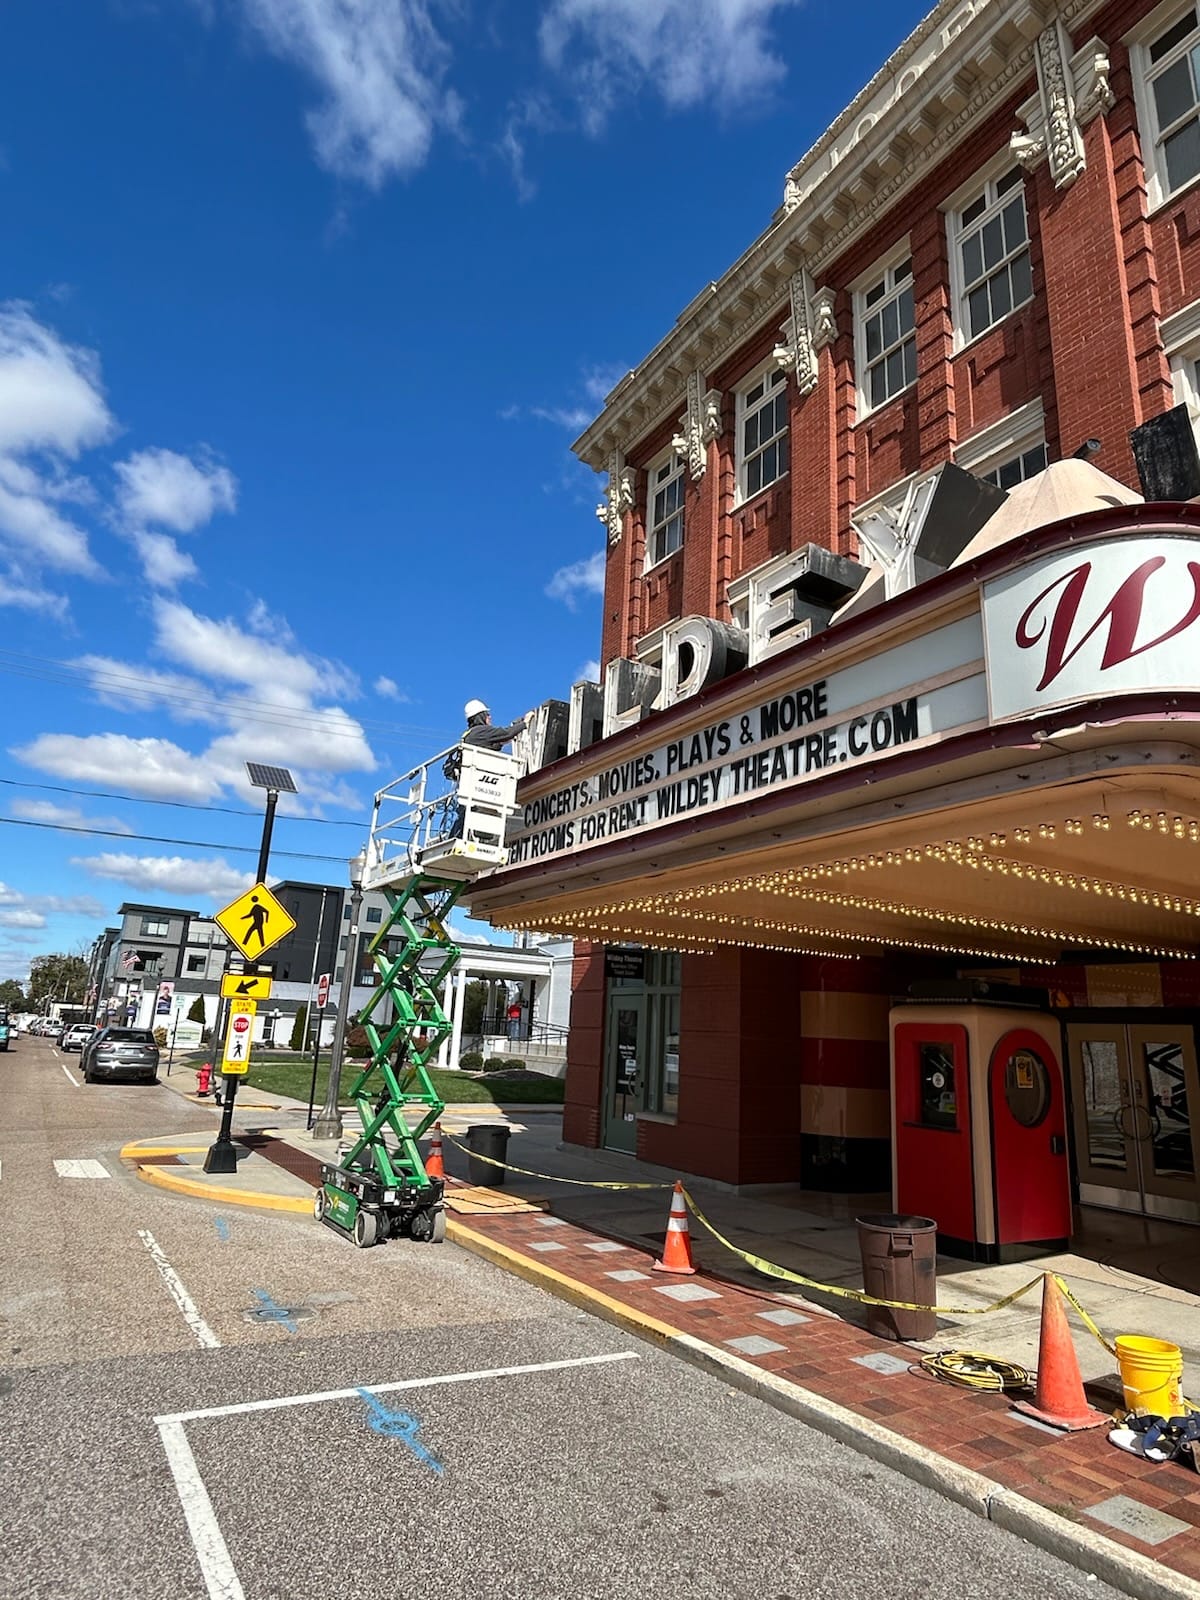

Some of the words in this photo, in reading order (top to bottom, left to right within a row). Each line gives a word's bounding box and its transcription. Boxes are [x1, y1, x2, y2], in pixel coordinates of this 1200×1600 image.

[667, 722, 731, 776] PLAYS
[740, 715, 753, 745] &
[761, 680, 827, 740] MORE
[478, 775, 500, 785] JLG
[531, 821, 575, 859] ROOMS
[579, 812, 606, 844] FOR
[657, 770, 722, 819] WILDEY
